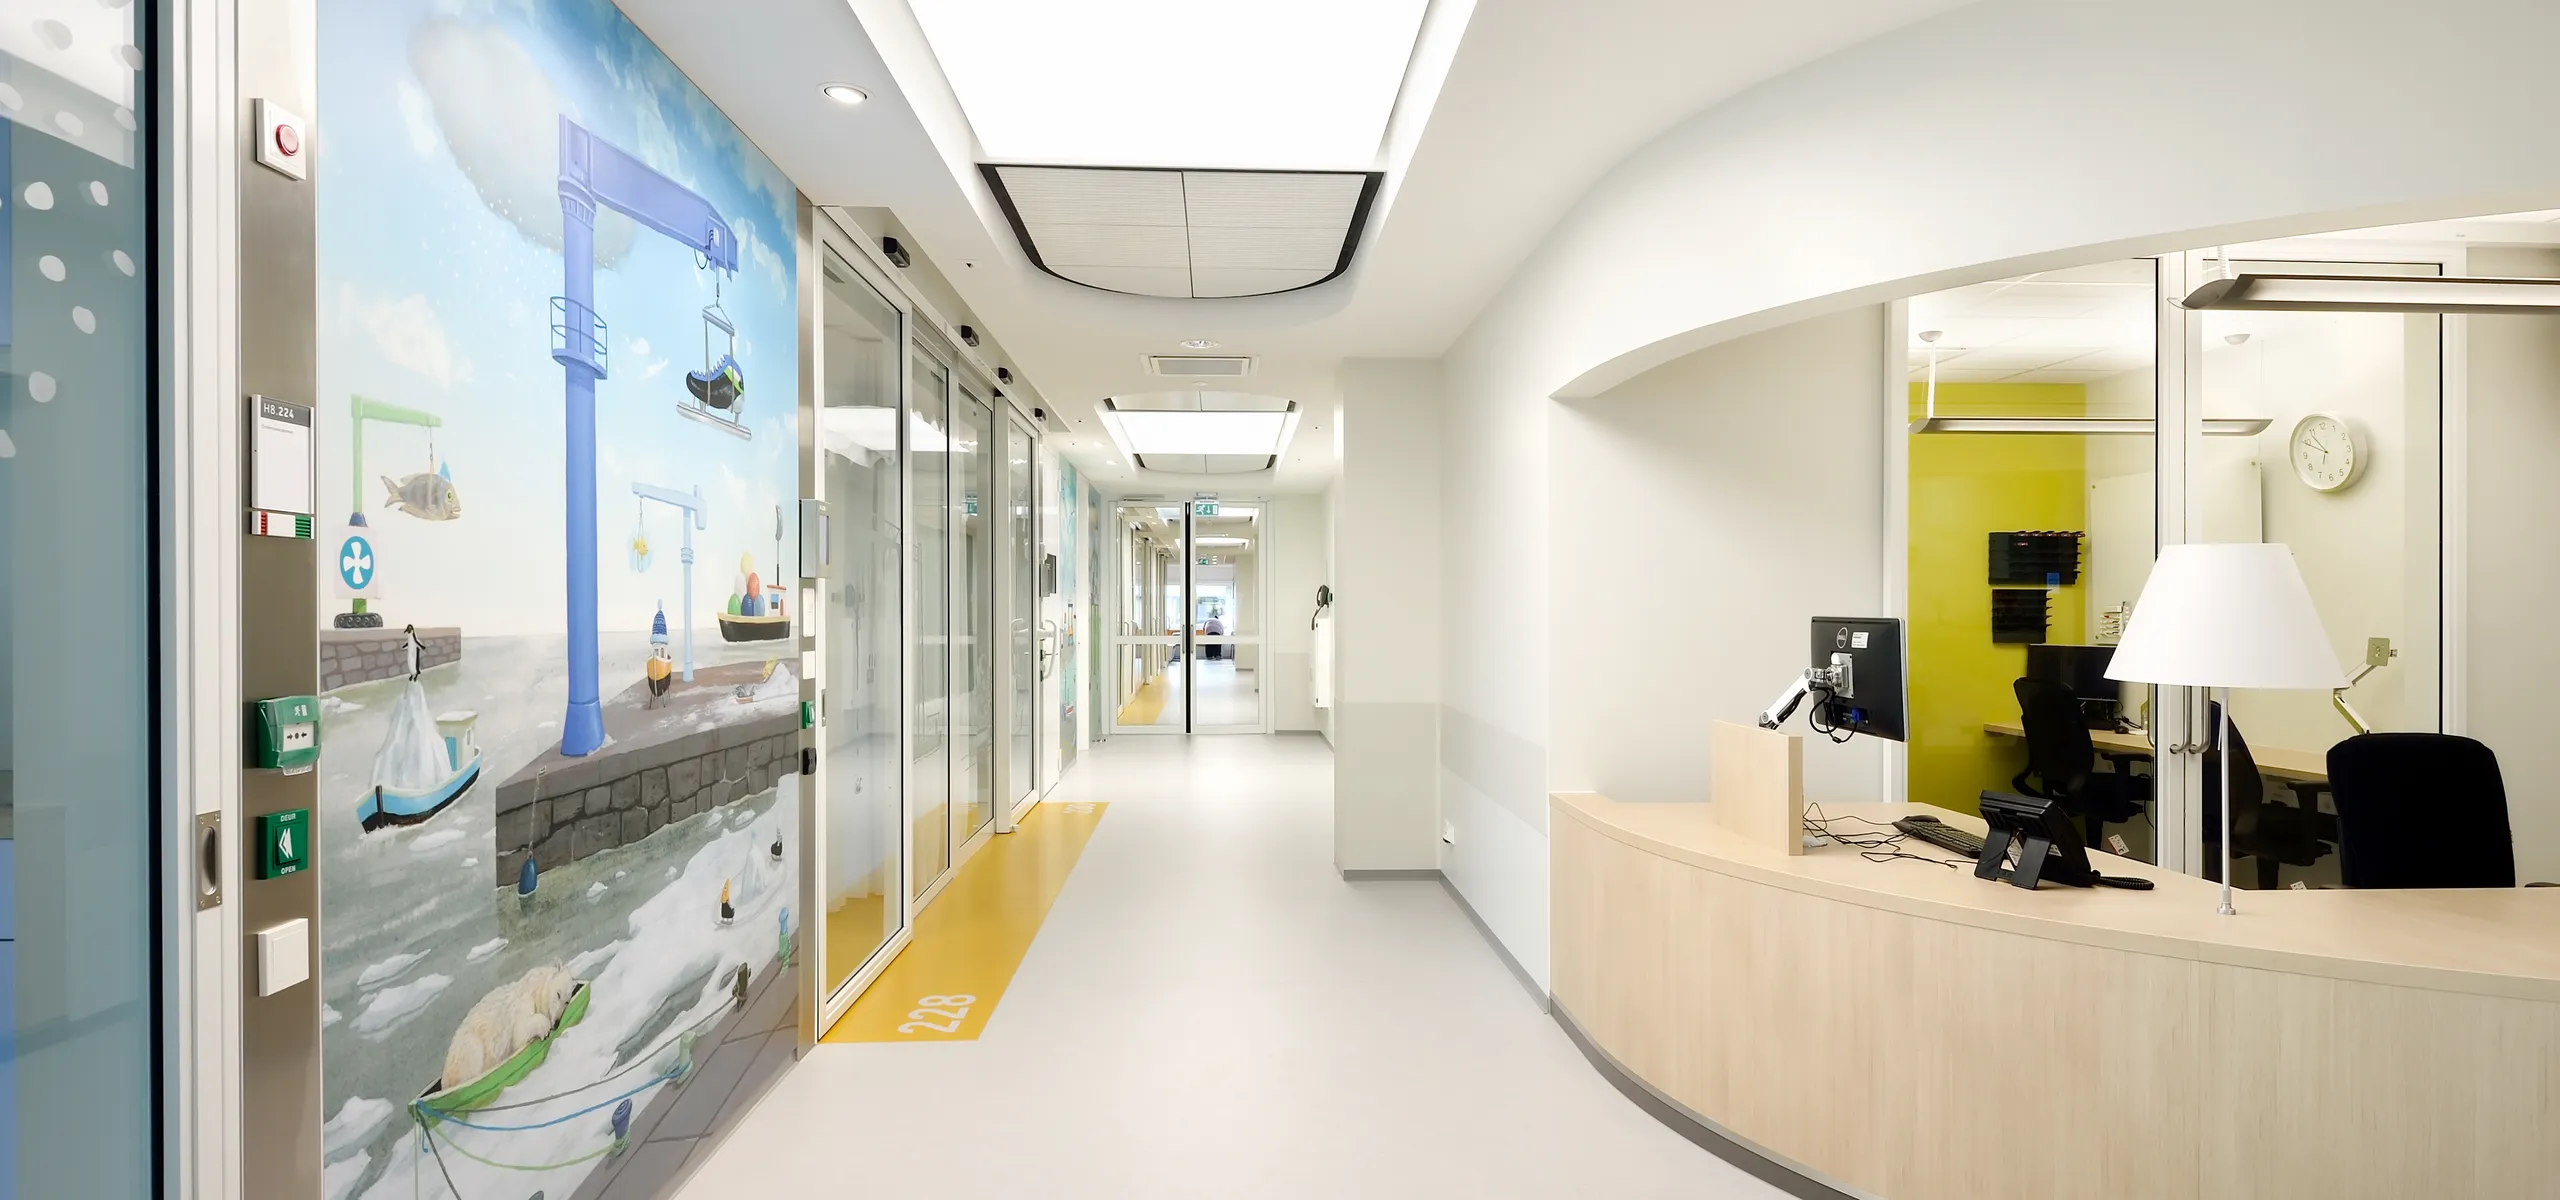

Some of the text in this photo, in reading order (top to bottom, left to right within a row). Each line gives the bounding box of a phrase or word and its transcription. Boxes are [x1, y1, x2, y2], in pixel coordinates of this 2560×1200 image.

[263, 403, 295, 419] H8.224
[2319, 422, 2326, 430] 12
[2308, 463, 2313, 471] 8
[280, 813, 296, 822] DEUR
[280, 865, 296, 875] OPEN
[898, 994, 976, 1033] 228
